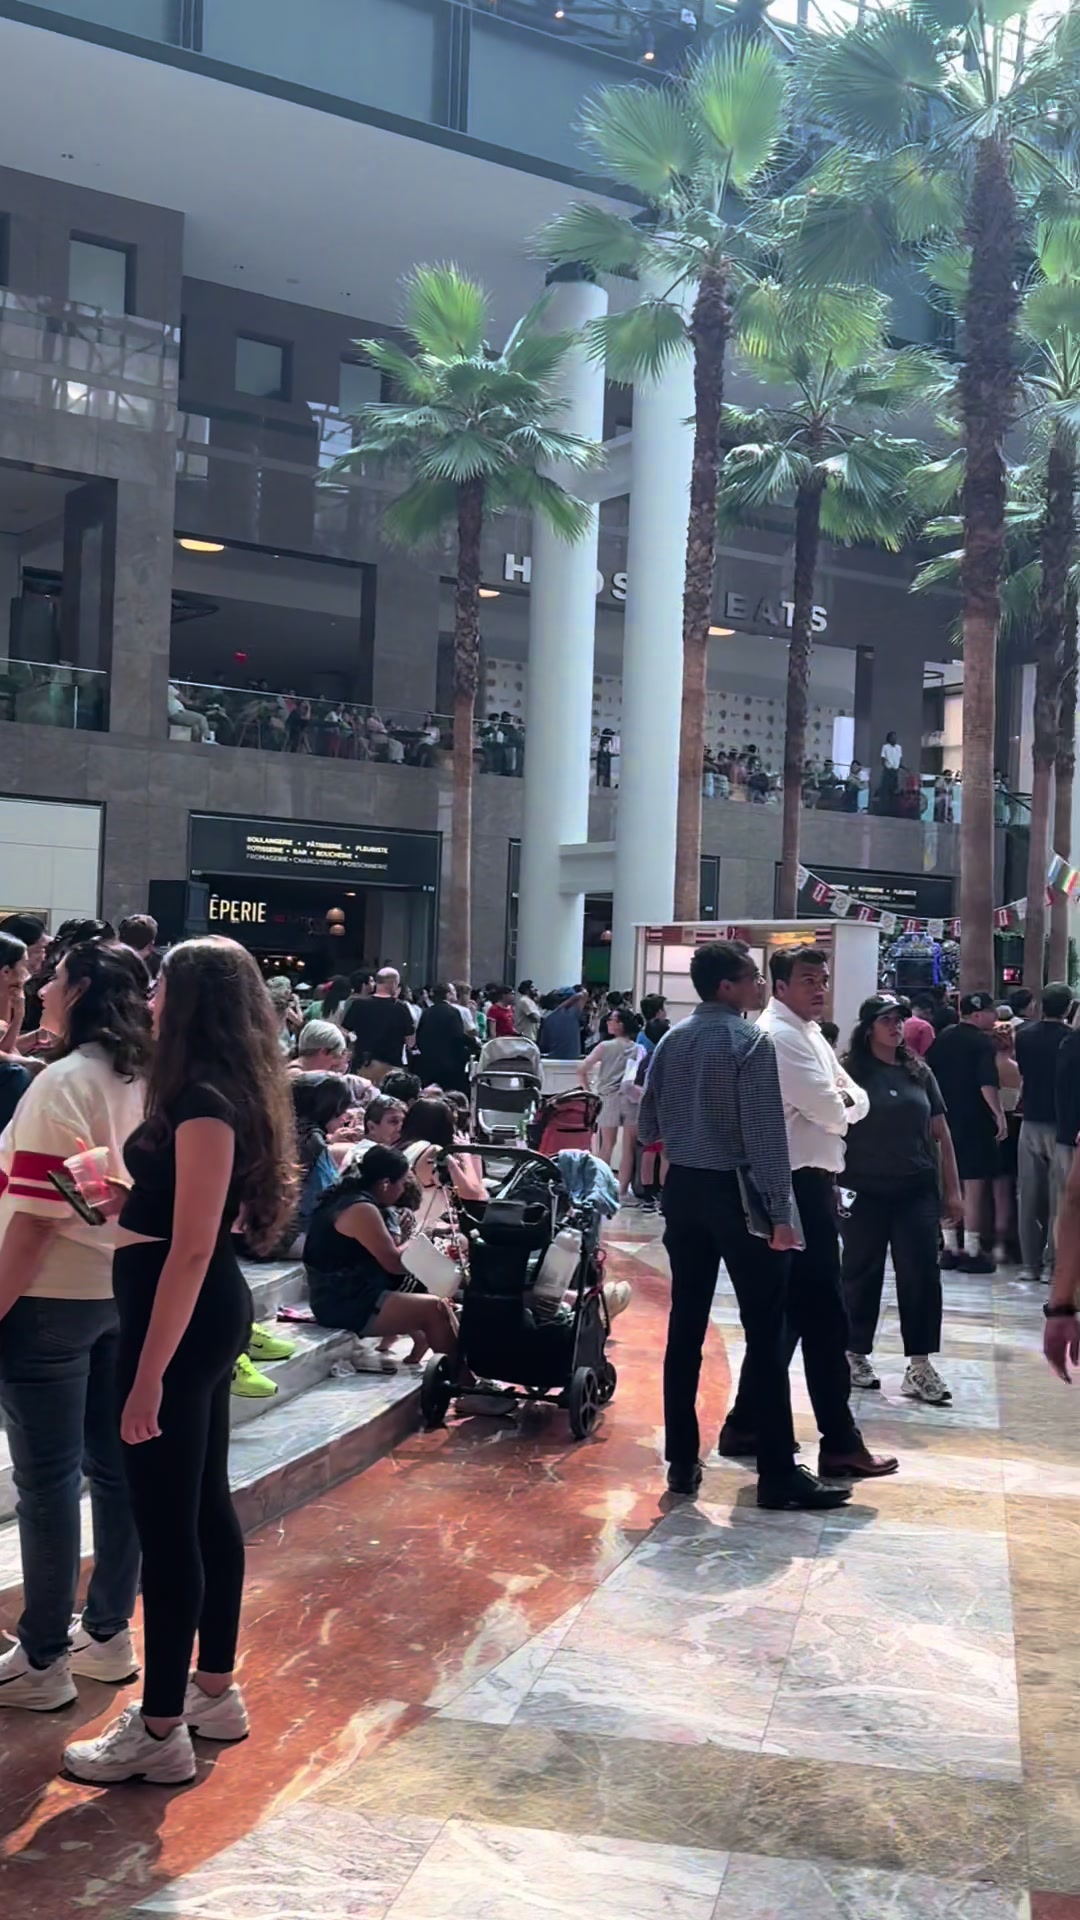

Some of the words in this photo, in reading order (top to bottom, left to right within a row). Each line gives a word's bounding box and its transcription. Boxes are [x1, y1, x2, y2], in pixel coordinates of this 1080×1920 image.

[725, 591, 828, 632] EATS
[293, 848, 308, 856] BAR
[209, 894, 267, 923] ÊPERIE
